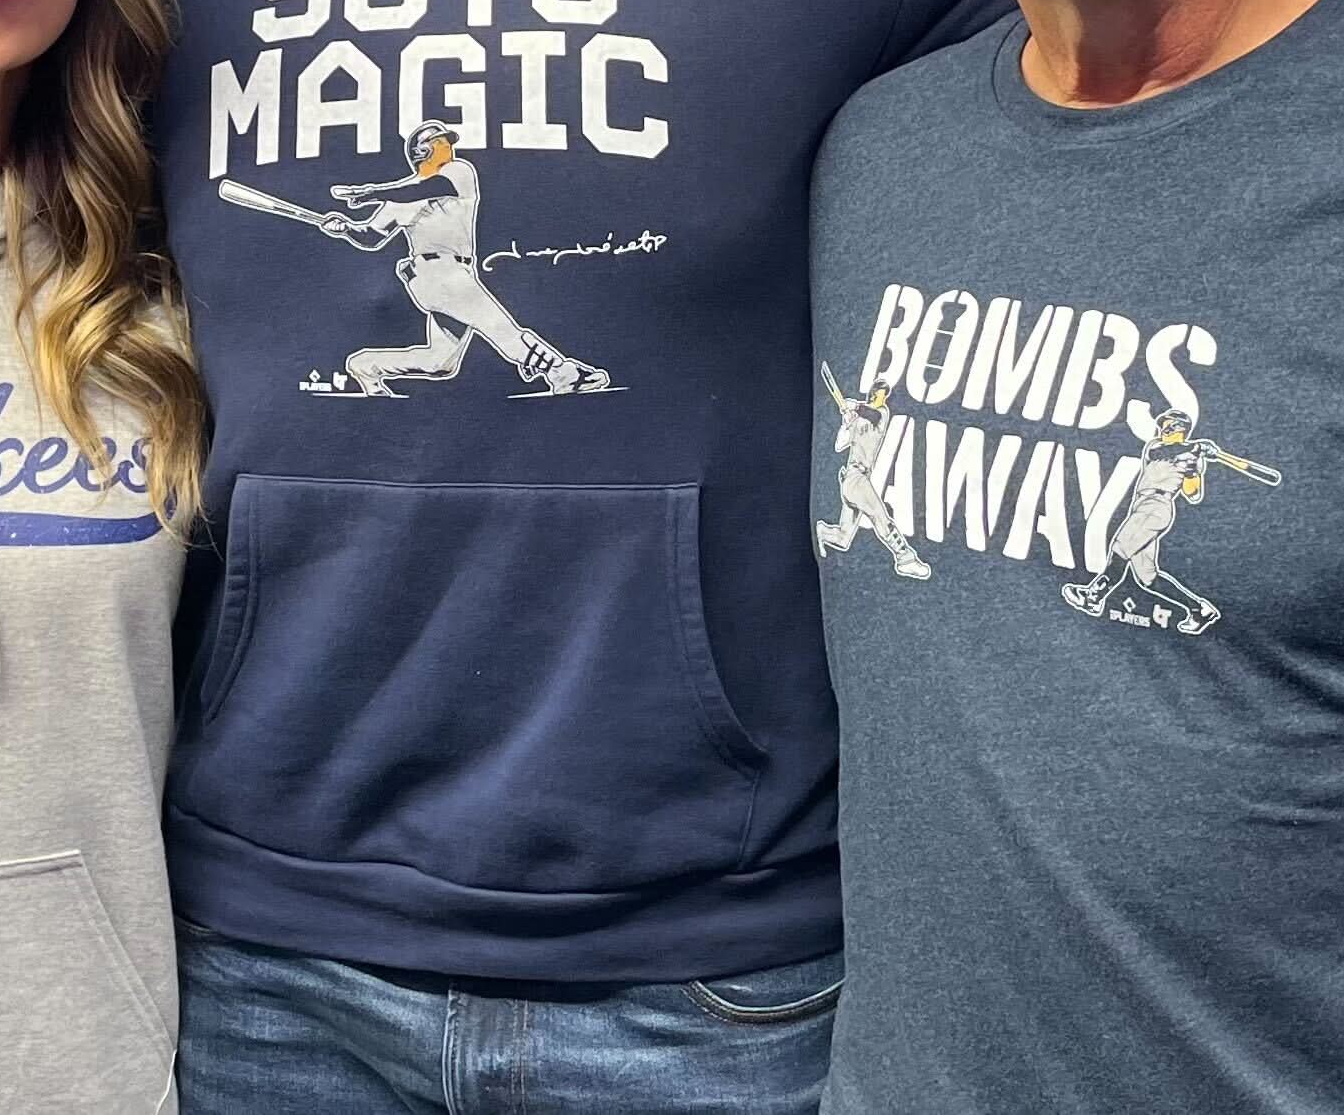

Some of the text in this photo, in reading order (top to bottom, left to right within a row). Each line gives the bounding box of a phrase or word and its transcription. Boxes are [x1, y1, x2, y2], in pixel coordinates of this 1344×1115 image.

[208, 30, 668, 179] MAGIC
[859, 283, 1217, 443] BOMBS
[856, 414, 1142, 574] AWAY
